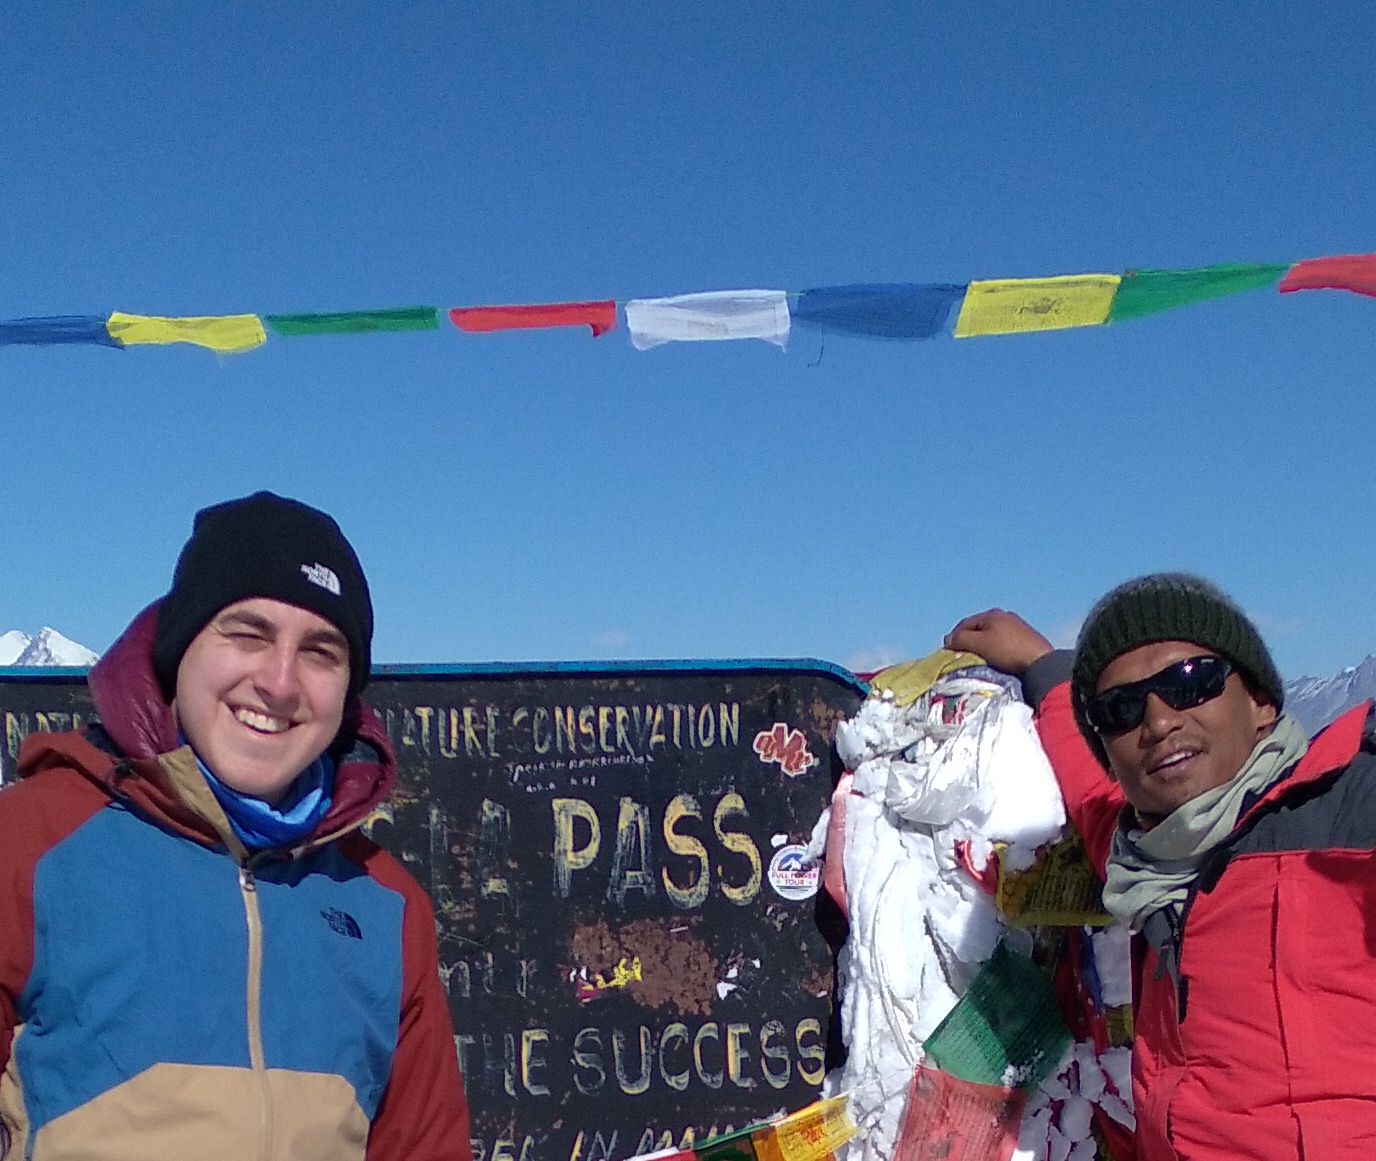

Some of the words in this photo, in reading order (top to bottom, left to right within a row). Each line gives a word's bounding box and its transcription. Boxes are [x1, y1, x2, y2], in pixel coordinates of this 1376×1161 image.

[512, 702, 740, 755] CONSERVATION
[551, 792, 763, 910] PASS
[454, 1028, 552, 1099] THE
[571, 1017, 825, 1096] SUCCESS
